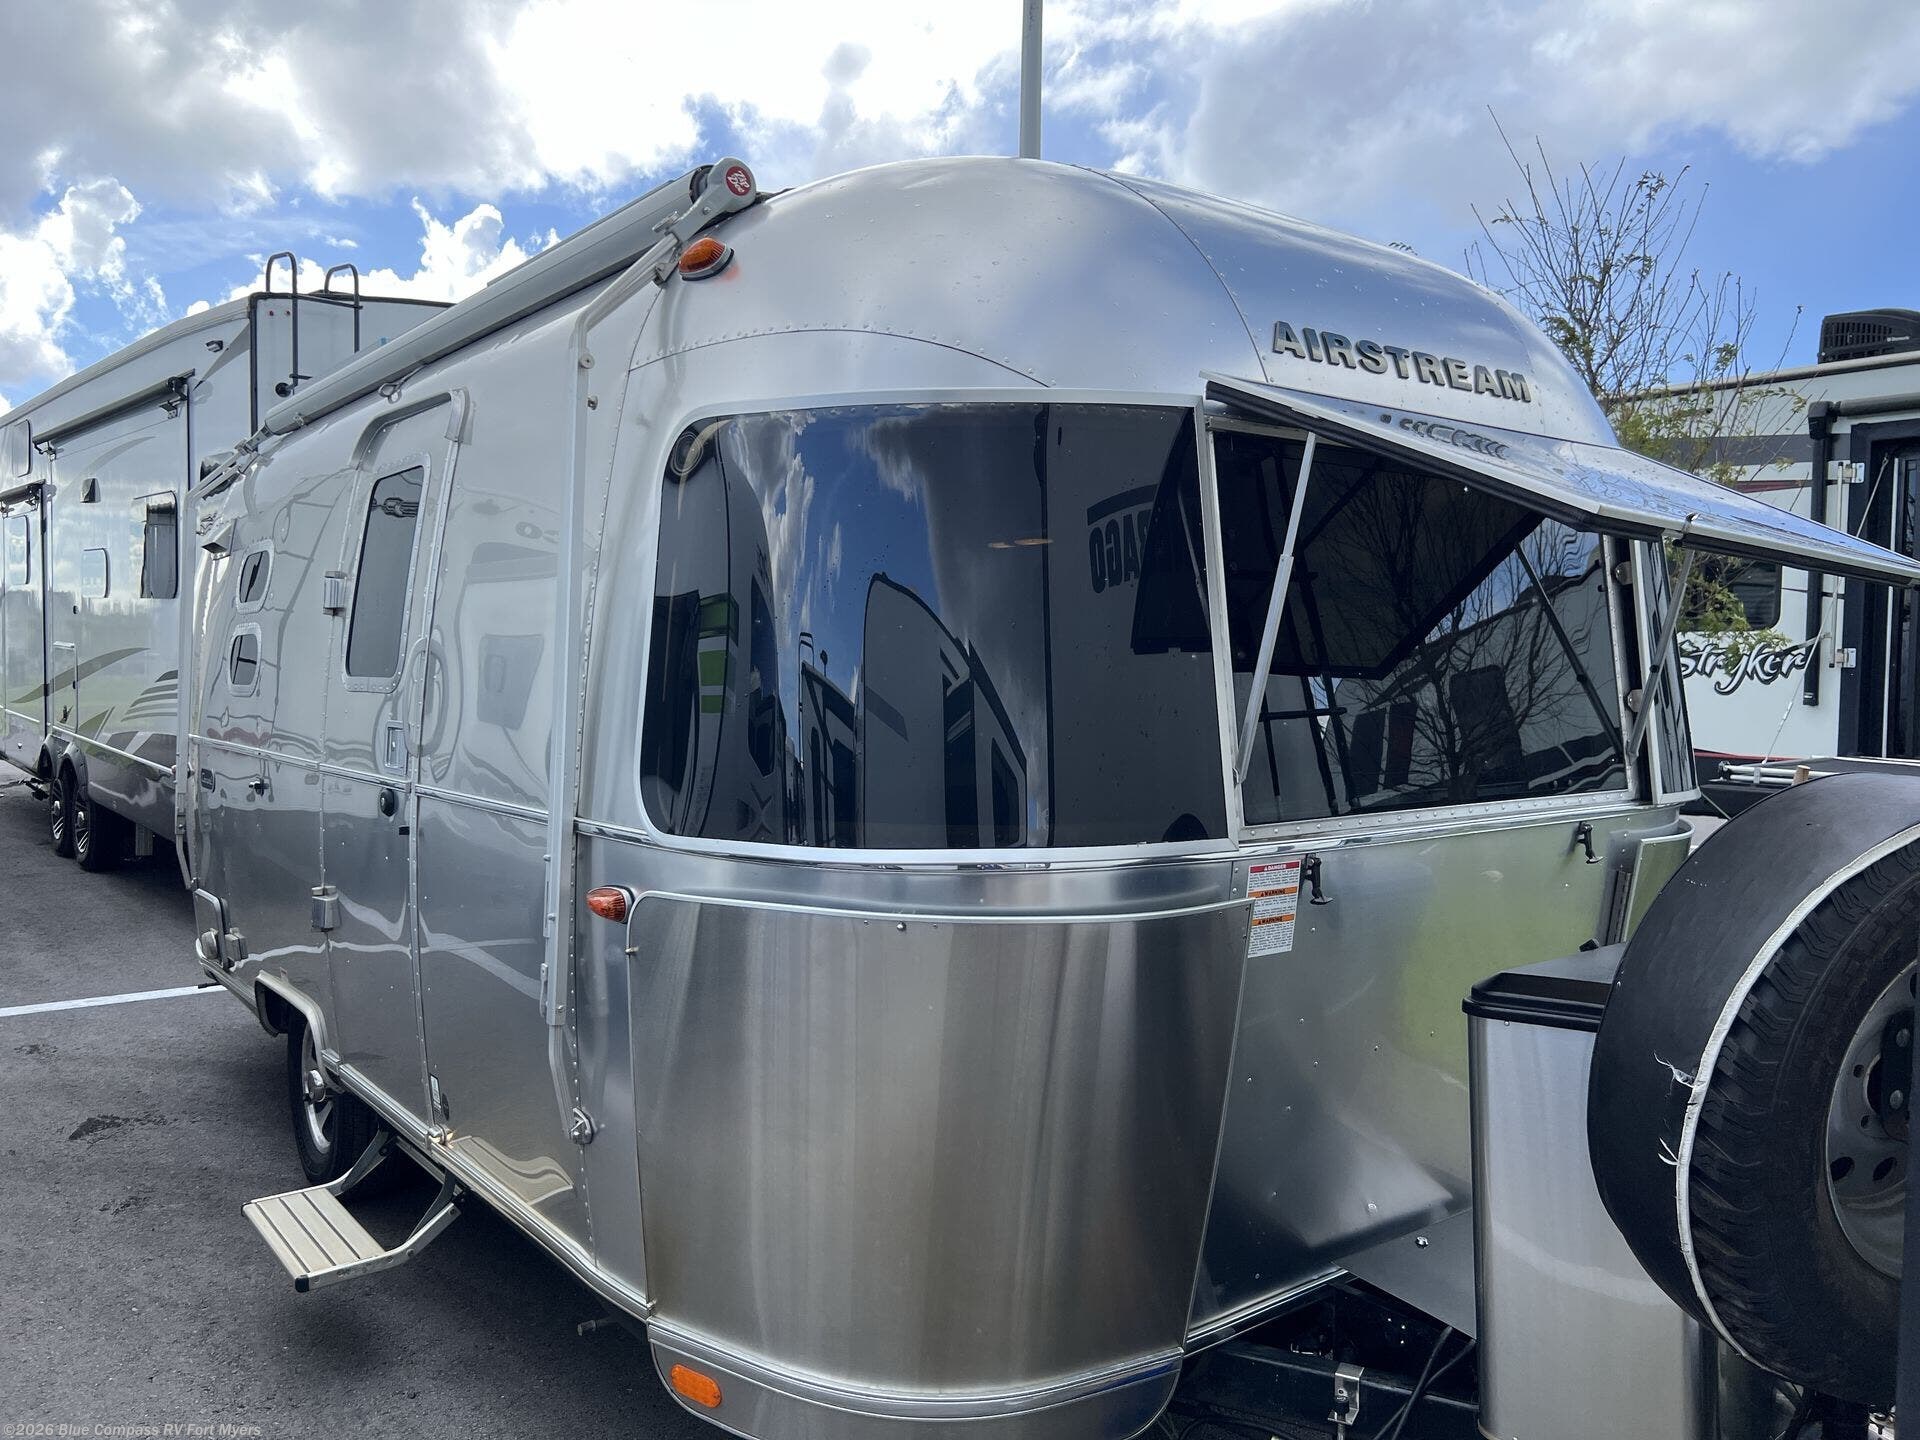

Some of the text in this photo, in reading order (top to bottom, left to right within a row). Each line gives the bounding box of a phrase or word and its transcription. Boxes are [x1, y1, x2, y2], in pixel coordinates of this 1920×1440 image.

[1272, 320, 1532, 403] AIRSTREAM
[1264, 888, 1286, 897] WARNING
[1261, 916, 1283, 925] WARNING
